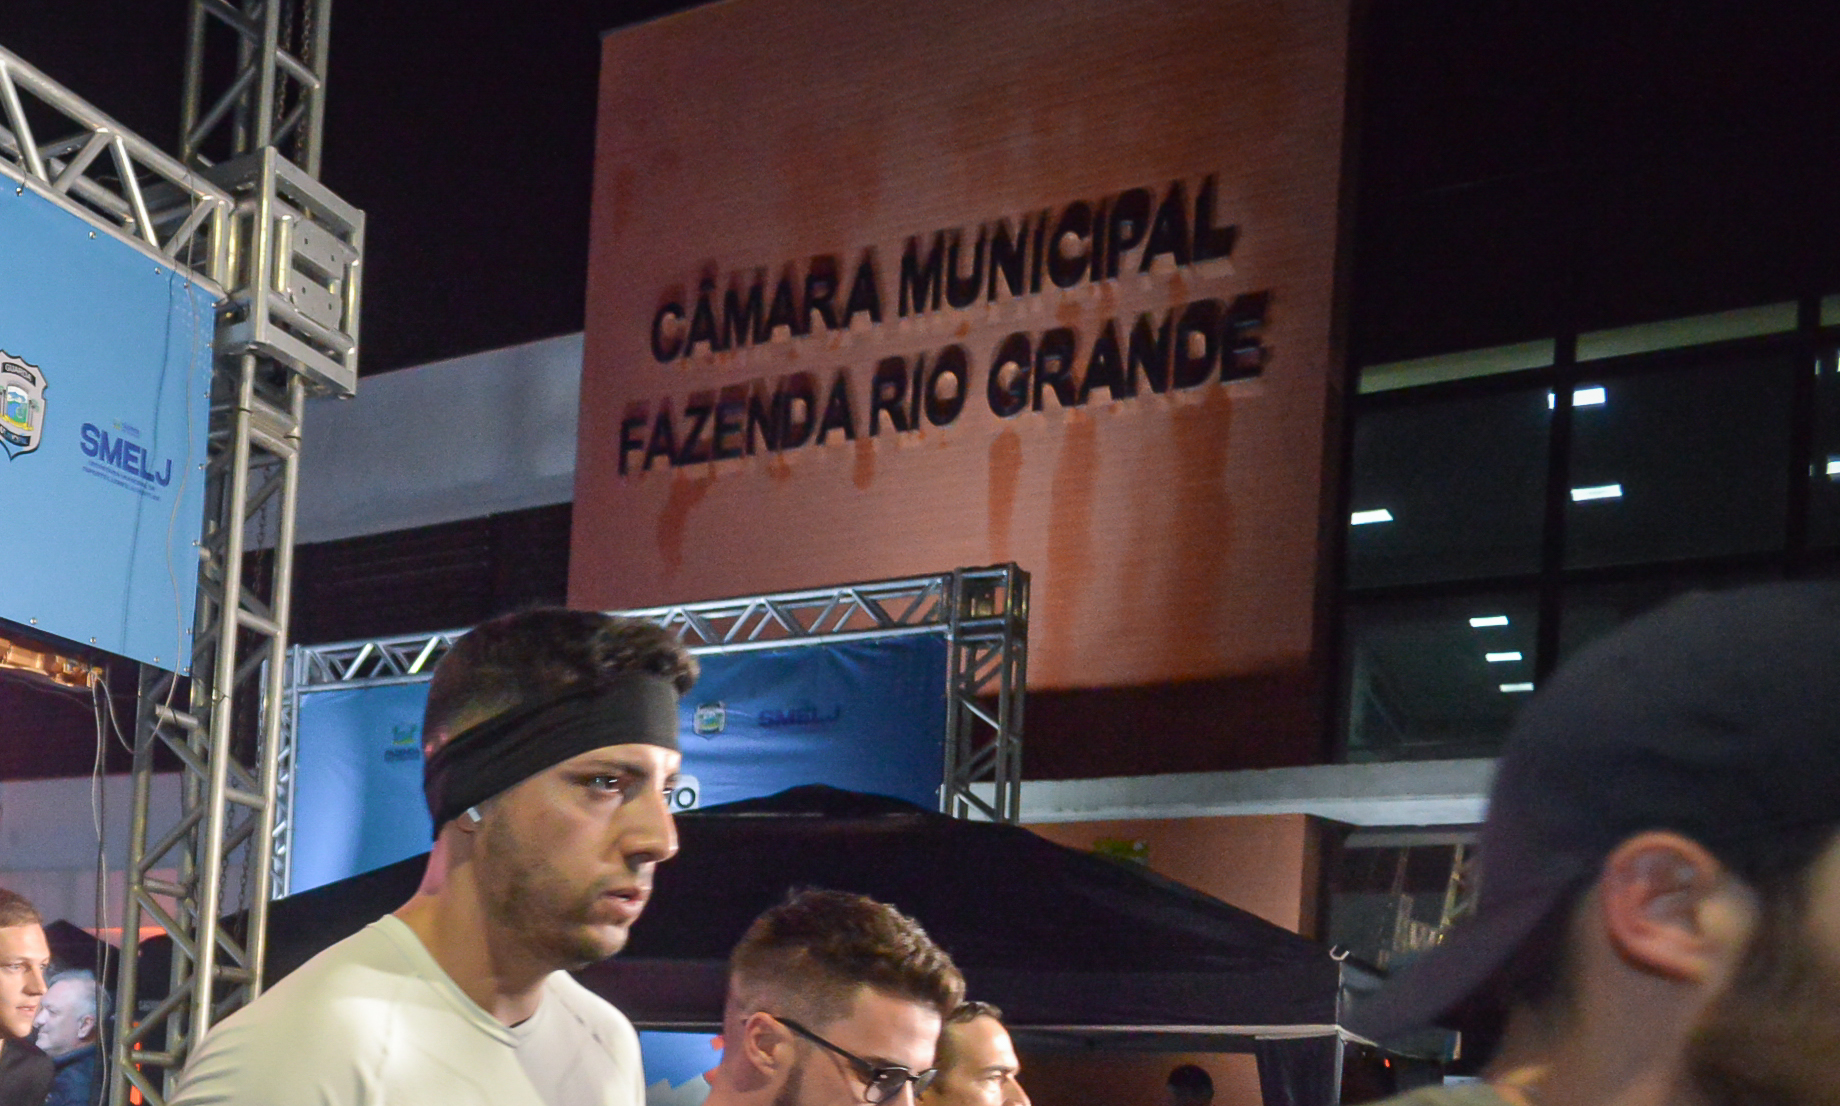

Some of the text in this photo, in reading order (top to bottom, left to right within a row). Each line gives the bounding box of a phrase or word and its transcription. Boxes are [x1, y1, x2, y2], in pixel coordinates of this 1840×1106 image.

[650, 173, 1240, 364] CÂMARA MUNICIPAL
[80, 422, 172, 487] SMELJ
[617, 289, 1273, 477] FAZENDA RIO GRANDE
